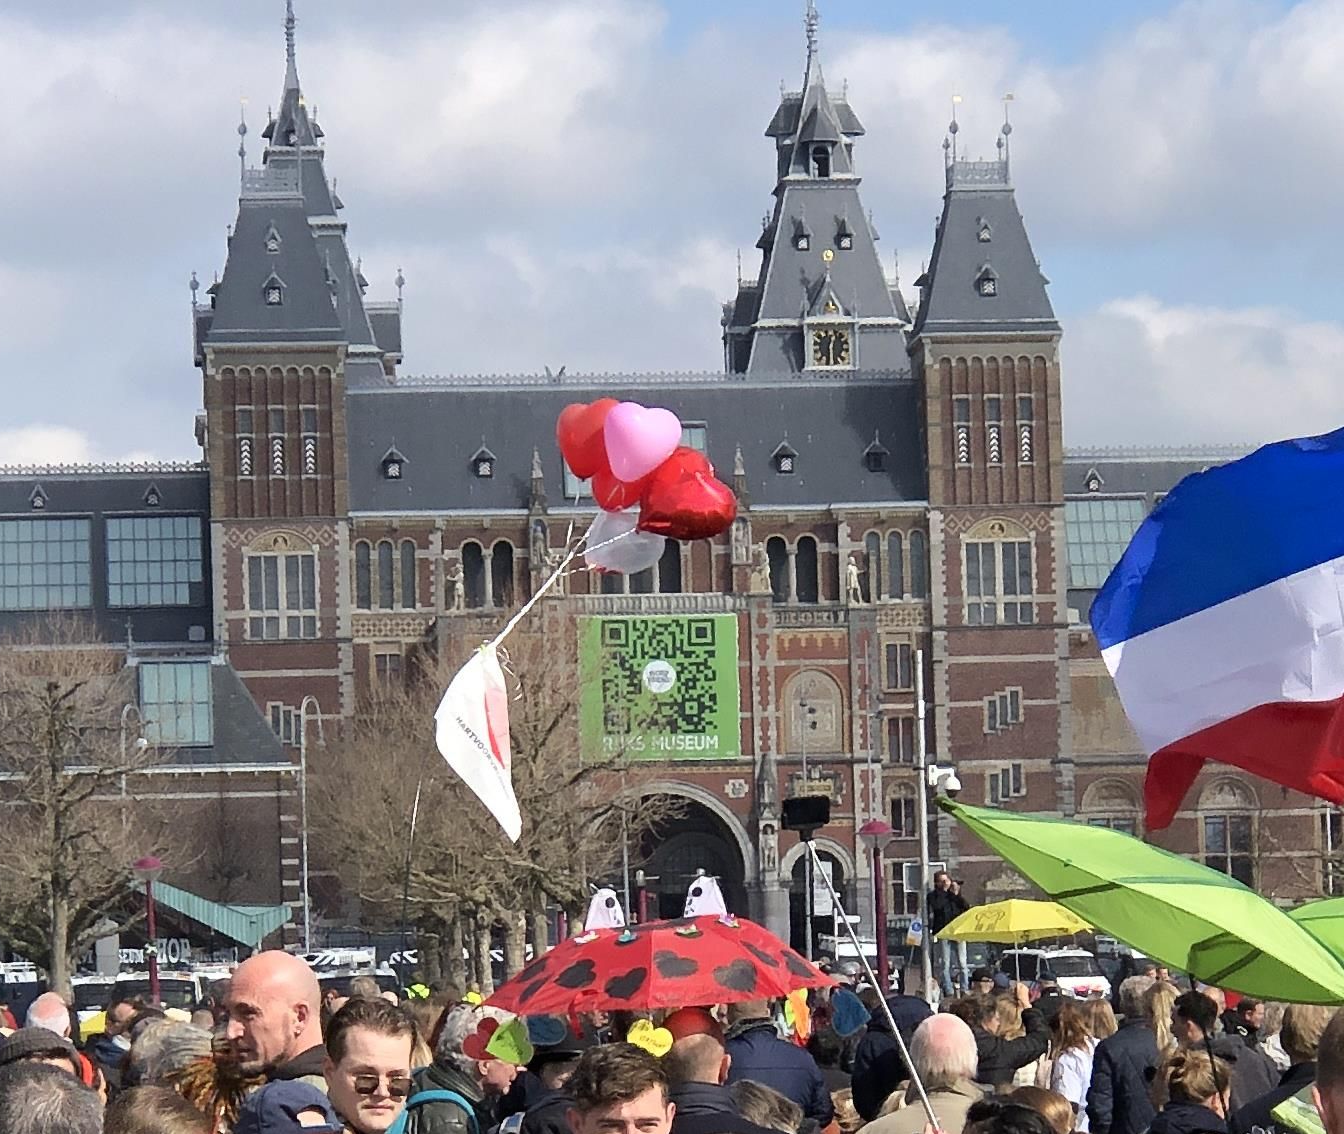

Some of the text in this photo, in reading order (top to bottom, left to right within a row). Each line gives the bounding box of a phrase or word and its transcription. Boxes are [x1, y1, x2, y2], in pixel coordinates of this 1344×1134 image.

[651, 734, 719, 751] MUSEUM
[119, 948, 144, 964] SEUM
[155, 937, 192, 964] HOP
